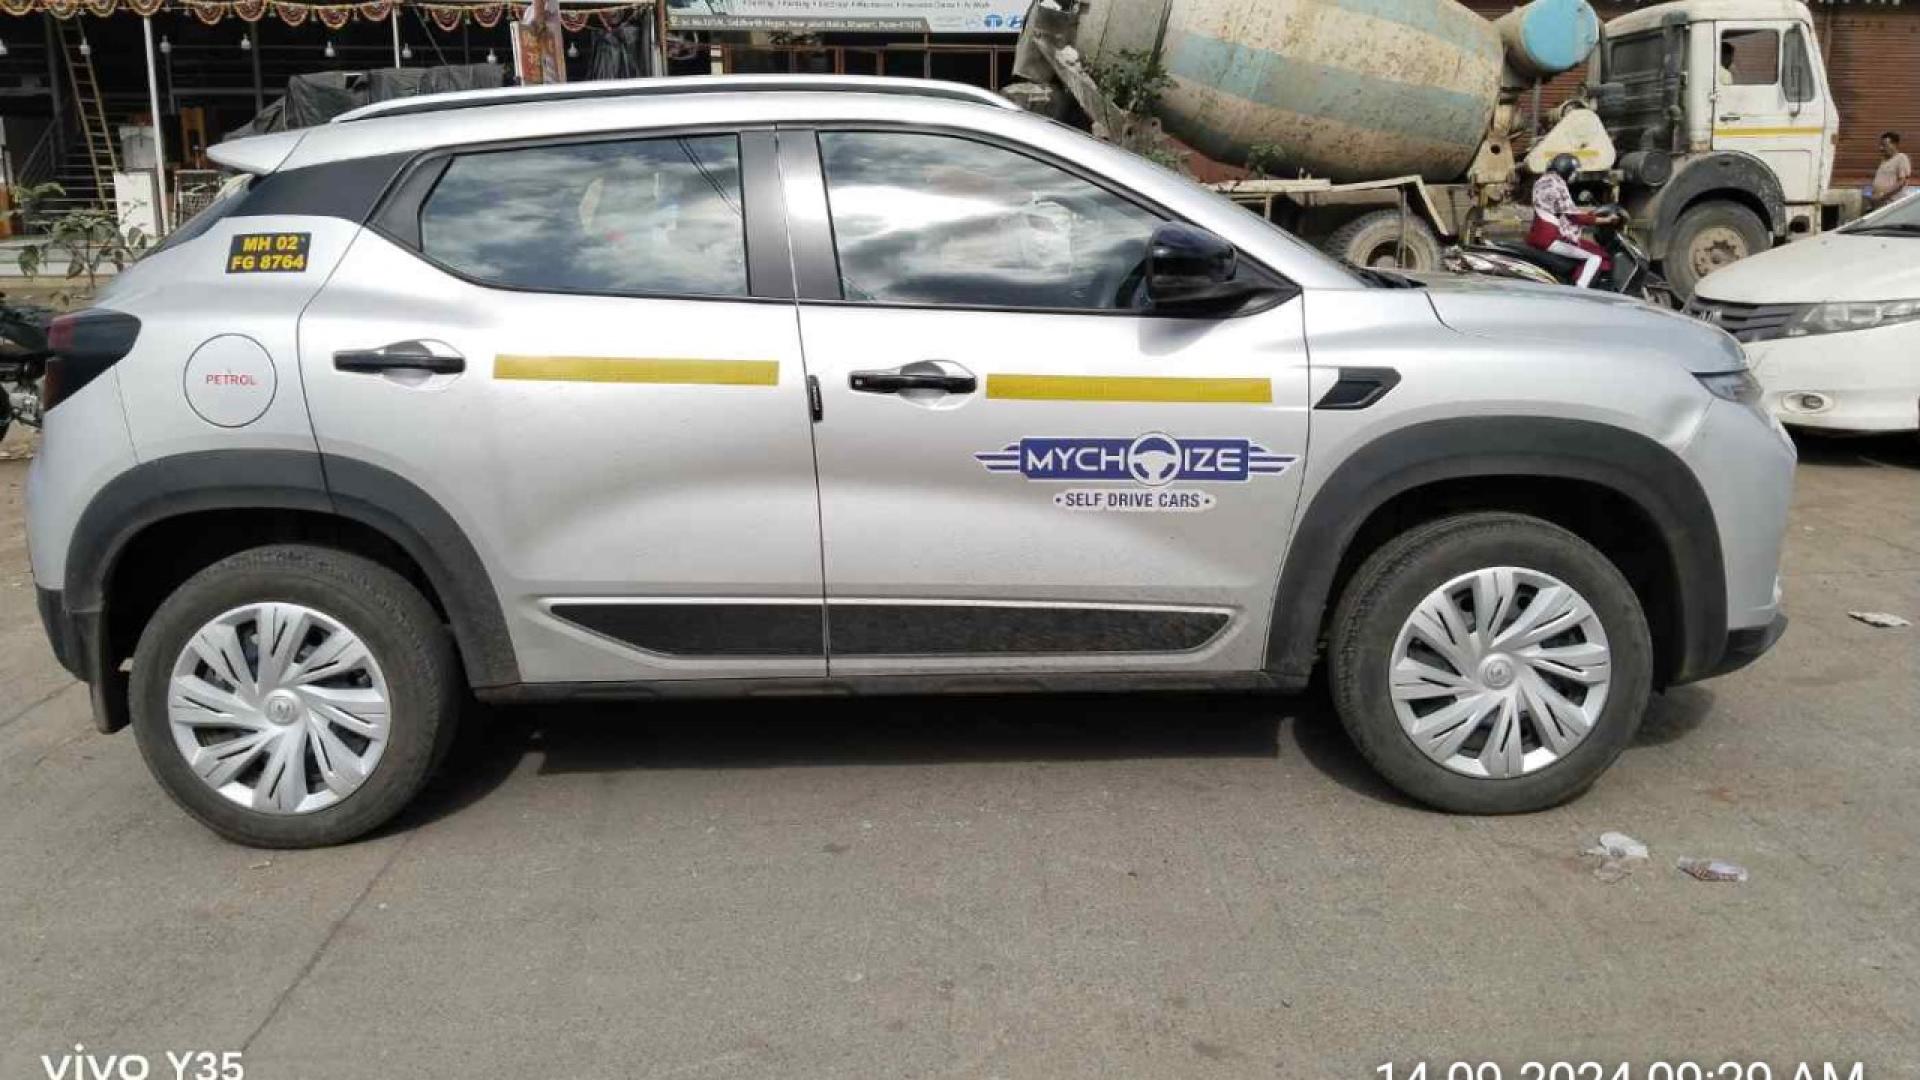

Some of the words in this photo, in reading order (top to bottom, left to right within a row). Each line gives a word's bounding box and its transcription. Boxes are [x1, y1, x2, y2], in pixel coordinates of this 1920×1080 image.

[243, 236, 271, 252] MH
[276, 235, 298, 250] 02
[231, 255, 255, 270] FG
[260, 254, 304, 269] 8764
[206, 374, 256, 385] PETROL
[1065, 492, 1102, 508] SELF
[1108, 492, 1153, 508] DRIVE
[1158, 493, 1200, 508] CARS
